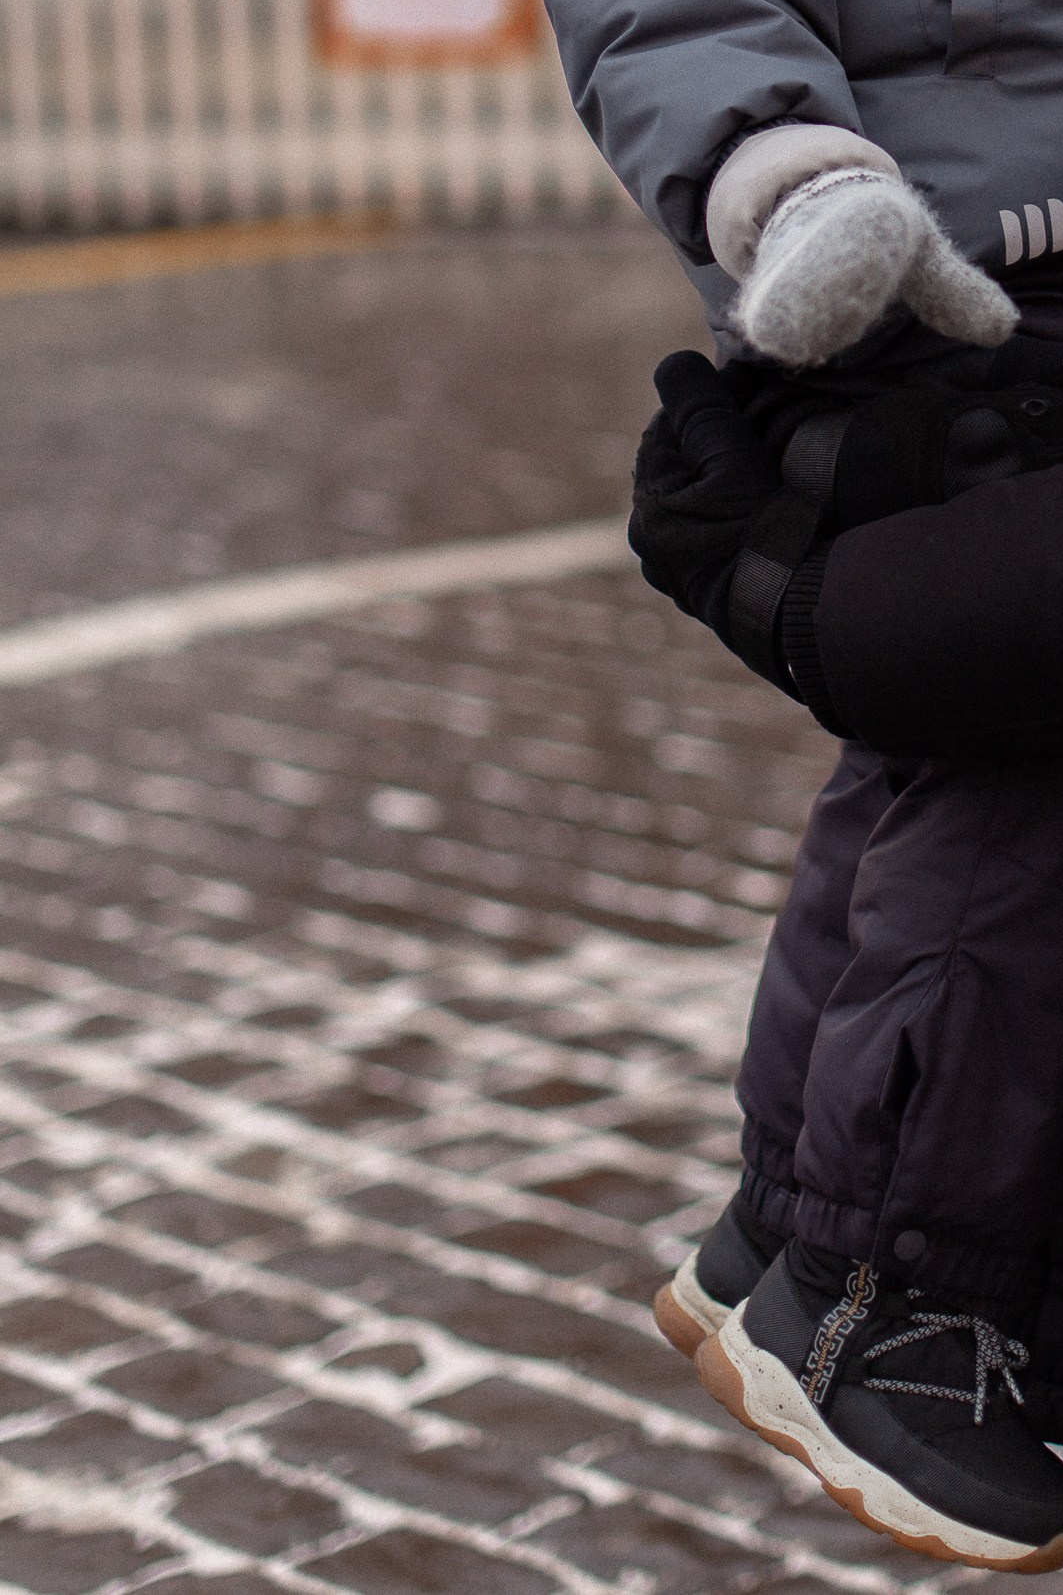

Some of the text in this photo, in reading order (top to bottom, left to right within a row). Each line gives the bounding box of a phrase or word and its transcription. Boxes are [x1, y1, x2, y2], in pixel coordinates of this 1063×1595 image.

[847, 1291, 866, 1316] Tombi
[827, 1313, 850, 1340] Tombi
[816, 1340, 832, 1371] Tombi
[806, 1371, 822, 1399] Tomb
